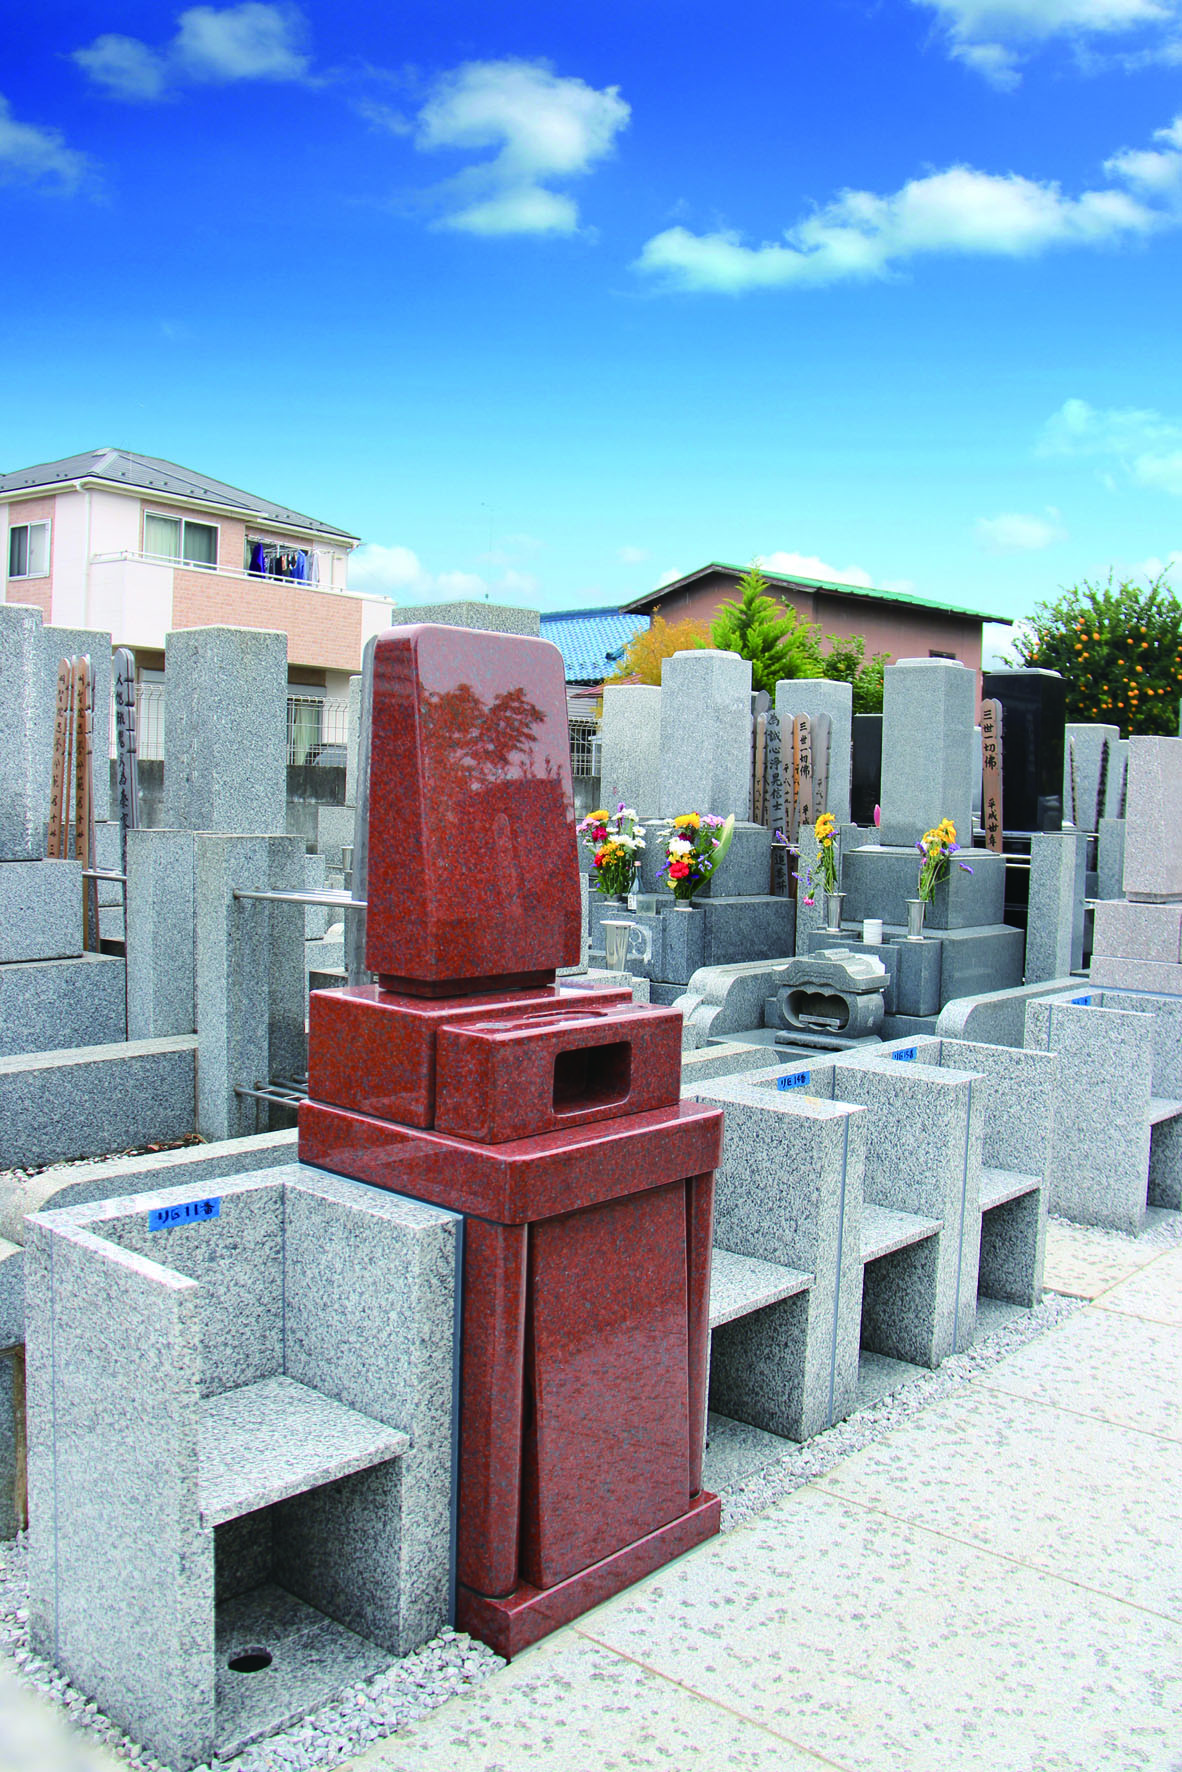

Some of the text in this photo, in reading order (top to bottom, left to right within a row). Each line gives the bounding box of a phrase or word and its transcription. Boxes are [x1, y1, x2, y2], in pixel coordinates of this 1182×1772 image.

[983, 709, 997, 770] 三世一切佛
